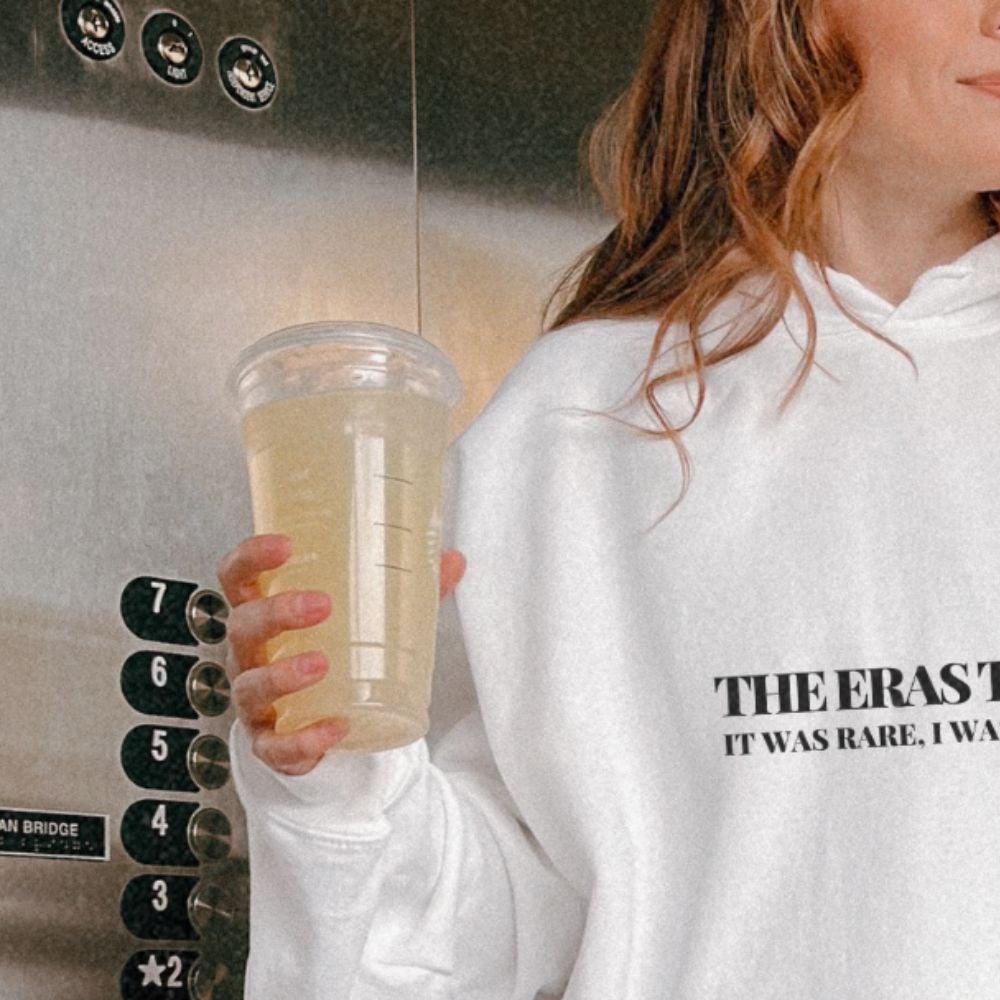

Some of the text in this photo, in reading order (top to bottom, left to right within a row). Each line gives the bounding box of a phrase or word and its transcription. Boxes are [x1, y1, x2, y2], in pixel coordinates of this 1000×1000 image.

[80, 37, 116, 56] ACCESS
[150, 581, 168, 614] 7
[151, 655, 168, 687] 6
[713, 671, 828, 717] THE
[834, 662, 972, 711] ERAS
[151, 729, 168, 761] 5
[723, 732, 755, 756] IT
[762, 728, 829, 754] WAS
[836, 722, 926, 751] RARE,
[931, 722, 942, 745] I
[22, 819, 79, 837] BRIDGE
[151, 804, 169, 836] 4
[152, 879, 168, 911] 3
